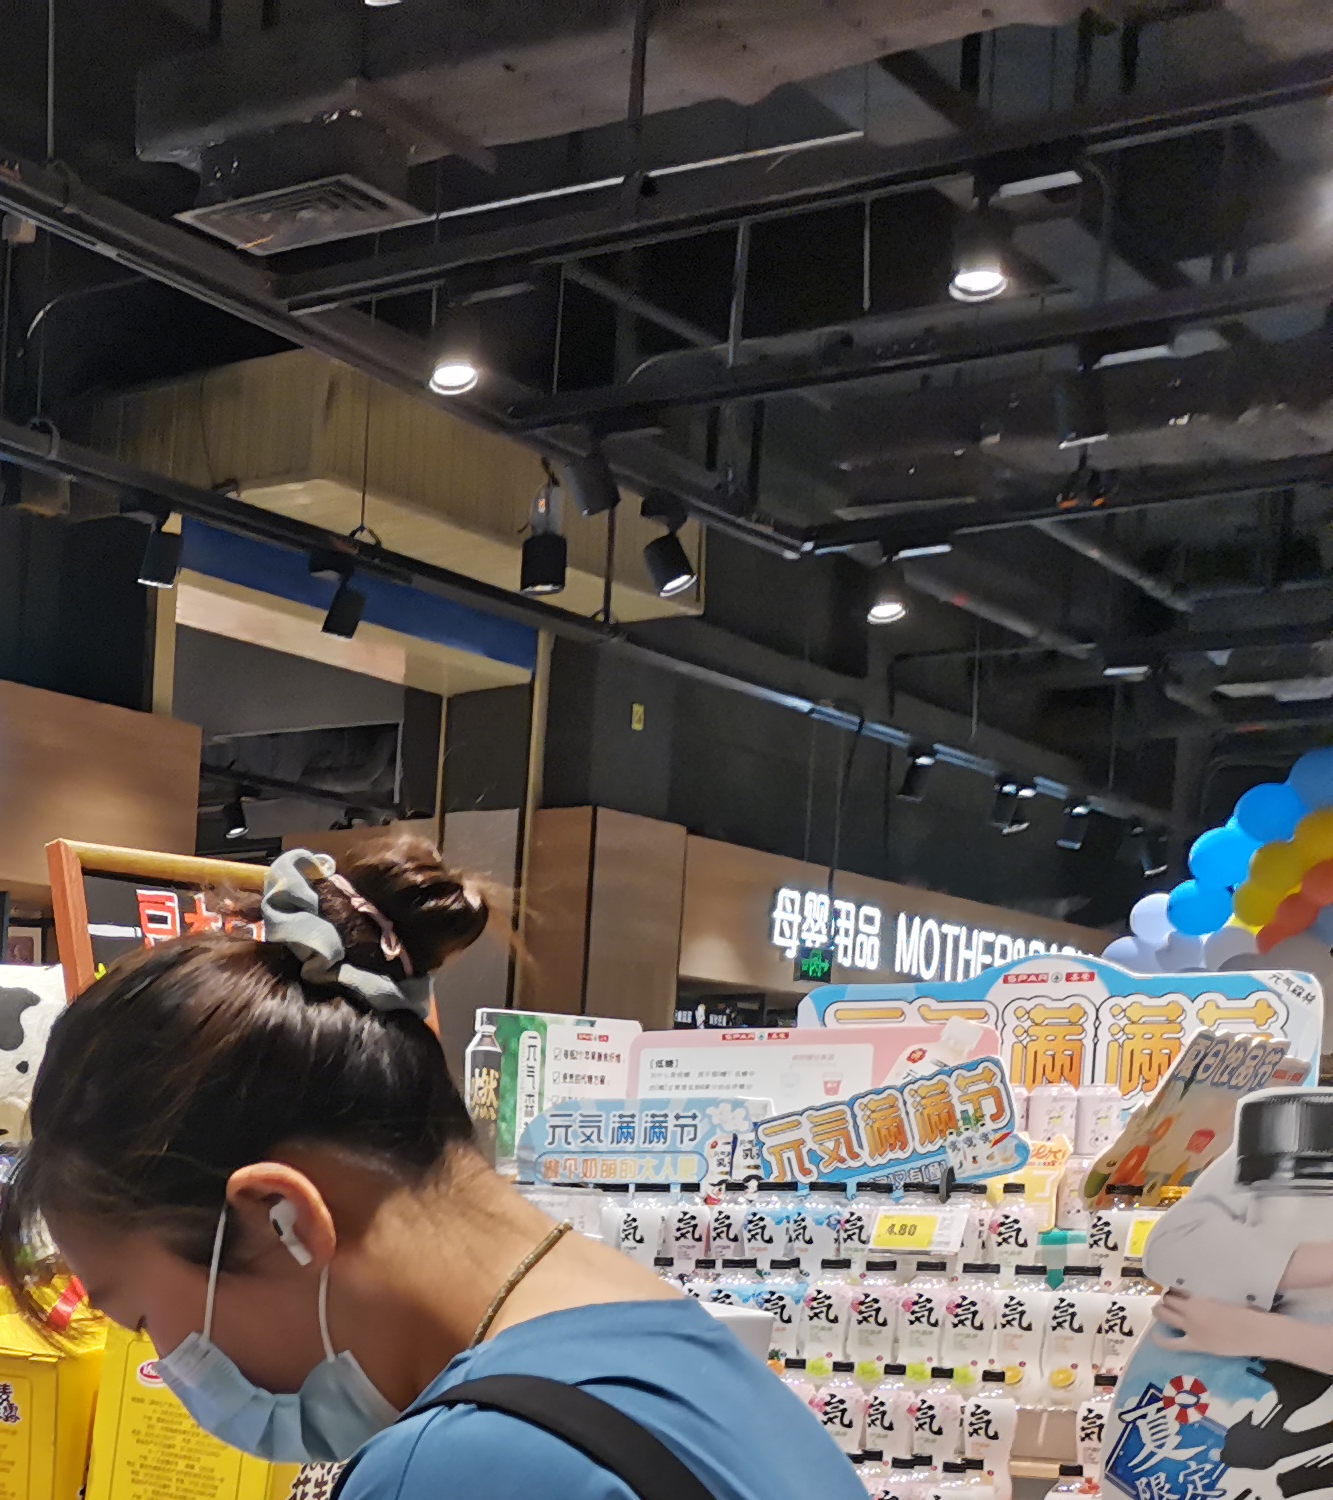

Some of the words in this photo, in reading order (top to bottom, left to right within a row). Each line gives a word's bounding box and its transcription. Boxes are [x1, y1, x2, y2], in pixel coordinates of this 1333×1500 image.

[773, 888, 881, 970] 母婴用品
[1006, 974, 1048, 983] SPAR
[886, 1224, 917, 1236] 4.80
